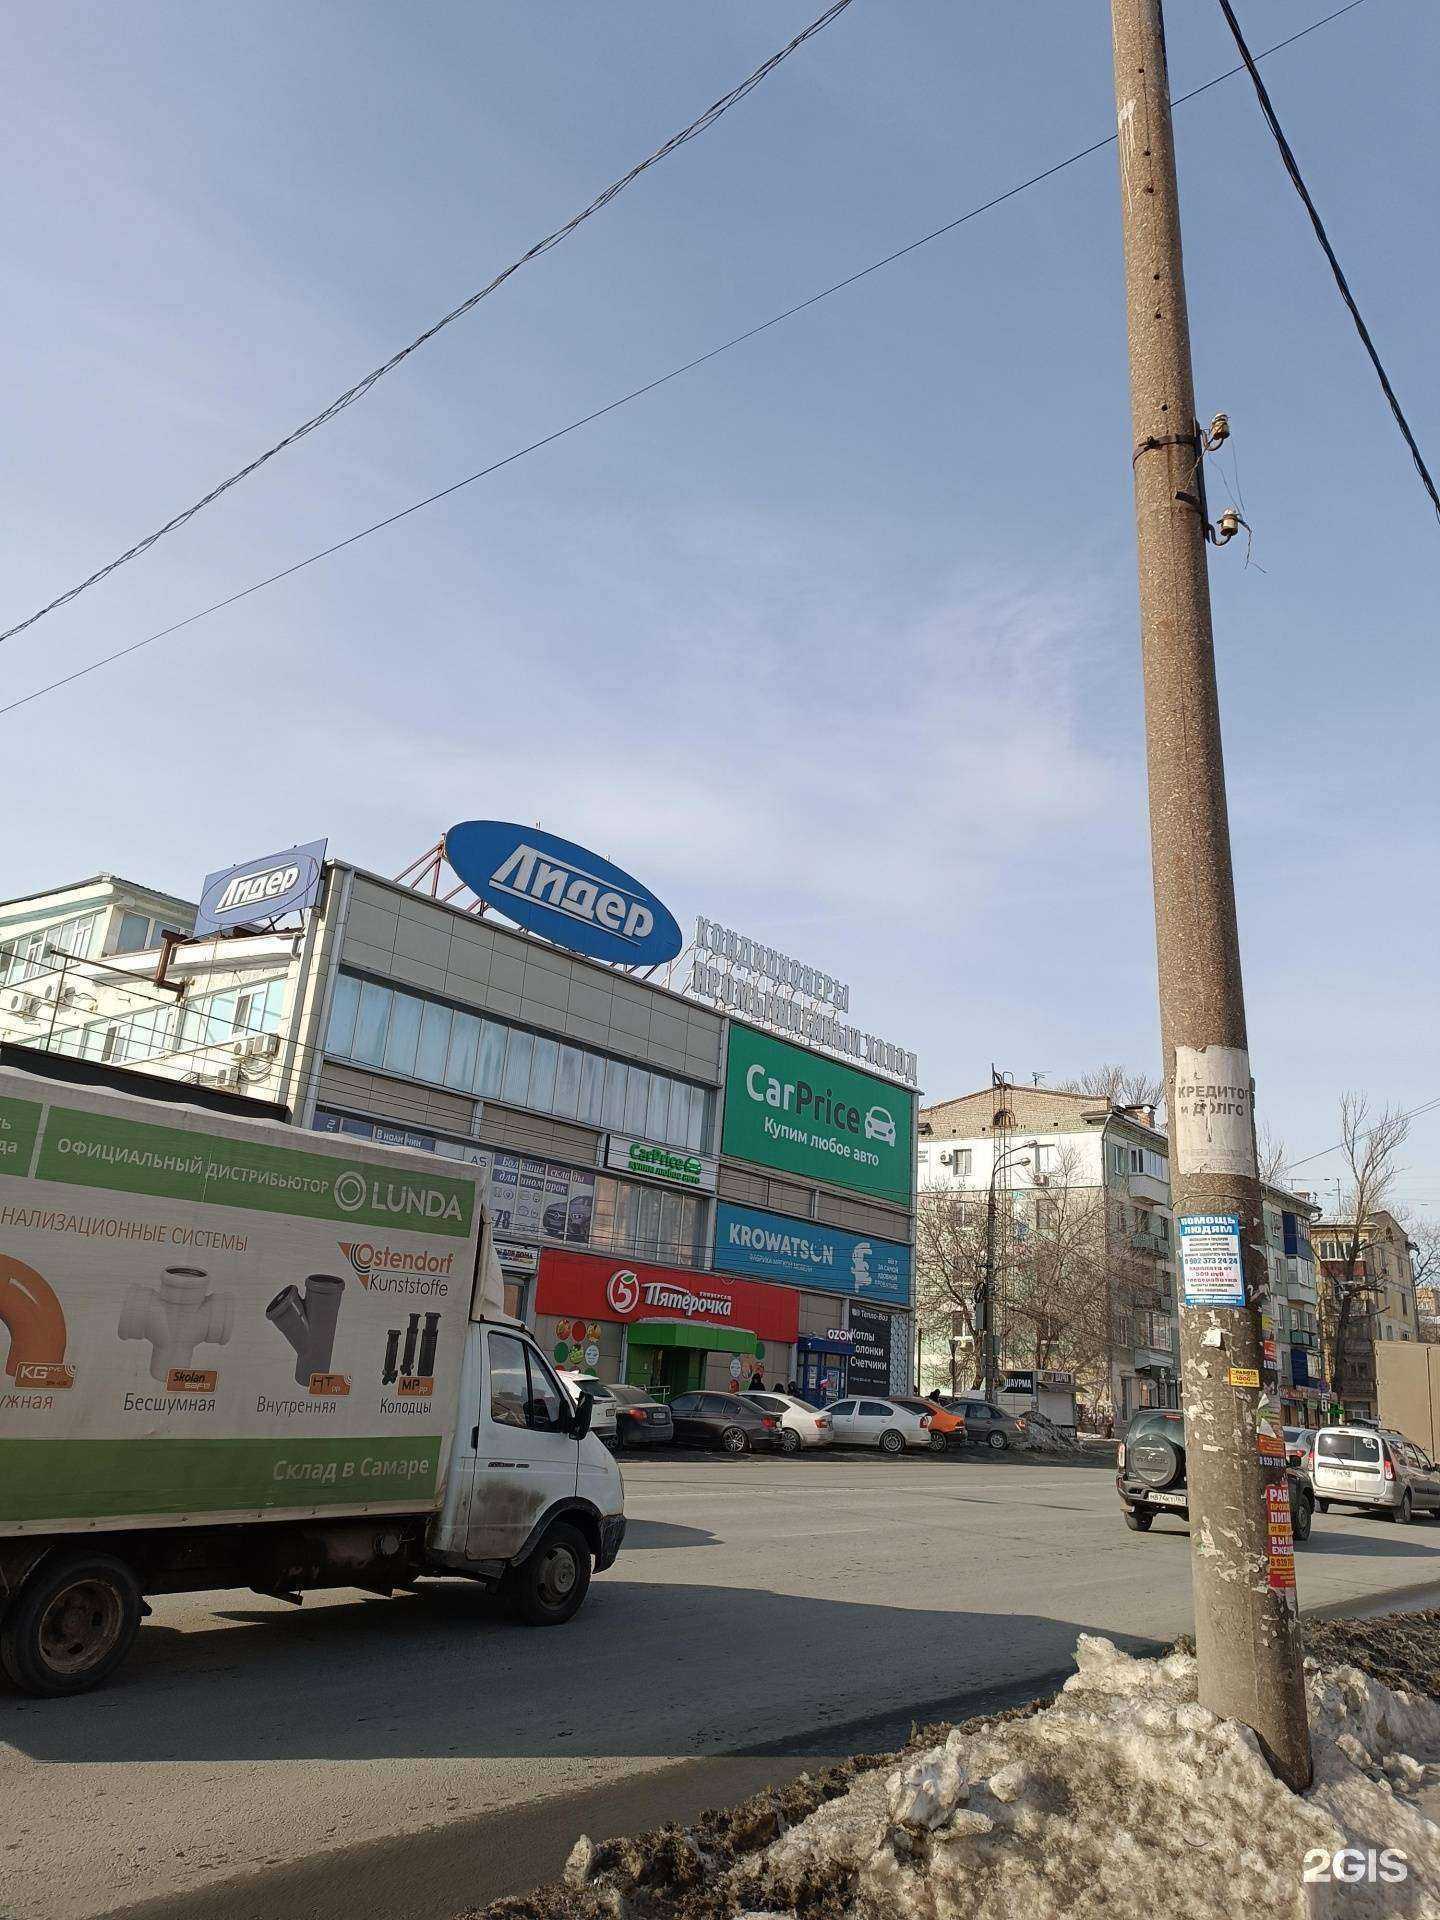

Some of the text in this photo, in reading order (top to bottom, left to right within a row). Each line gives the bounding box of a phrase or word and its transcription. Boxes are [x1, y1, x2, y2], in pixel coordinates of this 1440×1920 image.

[214, 865, 299, 913] Лидер
[490, 844, 654, 938] Лидер
[695, 915, 850, 1013] КОНДИЦИОНЕРЫ
[692, 959, 918, 1087] ПРОМЫШЛЕННЫЙ ХОЛОД
[746, 1064, 861, 1134] CarPrice
[764, 1116, 880, 1167] Купим любое авто
[57, 1137, 330, 1195] ОФИЦИАЛЬНЫЙ ДИСТРИБЬЮТОР
[371, 1181, 463, 1221] LUNDA
[1, 1206, 249, 1252] НАЛИЗАЦИОННЫЕ СИСТЕМЫ
[1180, 1216, 1236, 1226] ПОМОЩЬ
[1184, 1225, 1233, 1235] ЛЮДЯМ
[356, 1242, 454, 1274] Ostendorf
[369, 1273, 449, 1297] Kunststoffe
[828, 1329, 852, 1341] OZON
[851, 1328, 875, 1342] Котлы
[855, 1344, 884, 1357] олонки
[20, 1366, 48, 1379] KG
[173, 1371, 206, 1383] Skolan
[1004, 1377, 1033, 1389] ШАУРМА
[123, 1392, 216, 1415] Бесшумная
[256, 1395, 337, 1416] Внутренняя
[379, 1398, 432, 1415] Колодцы
[272, 1456, 430, 1484] Склад в Самаре
